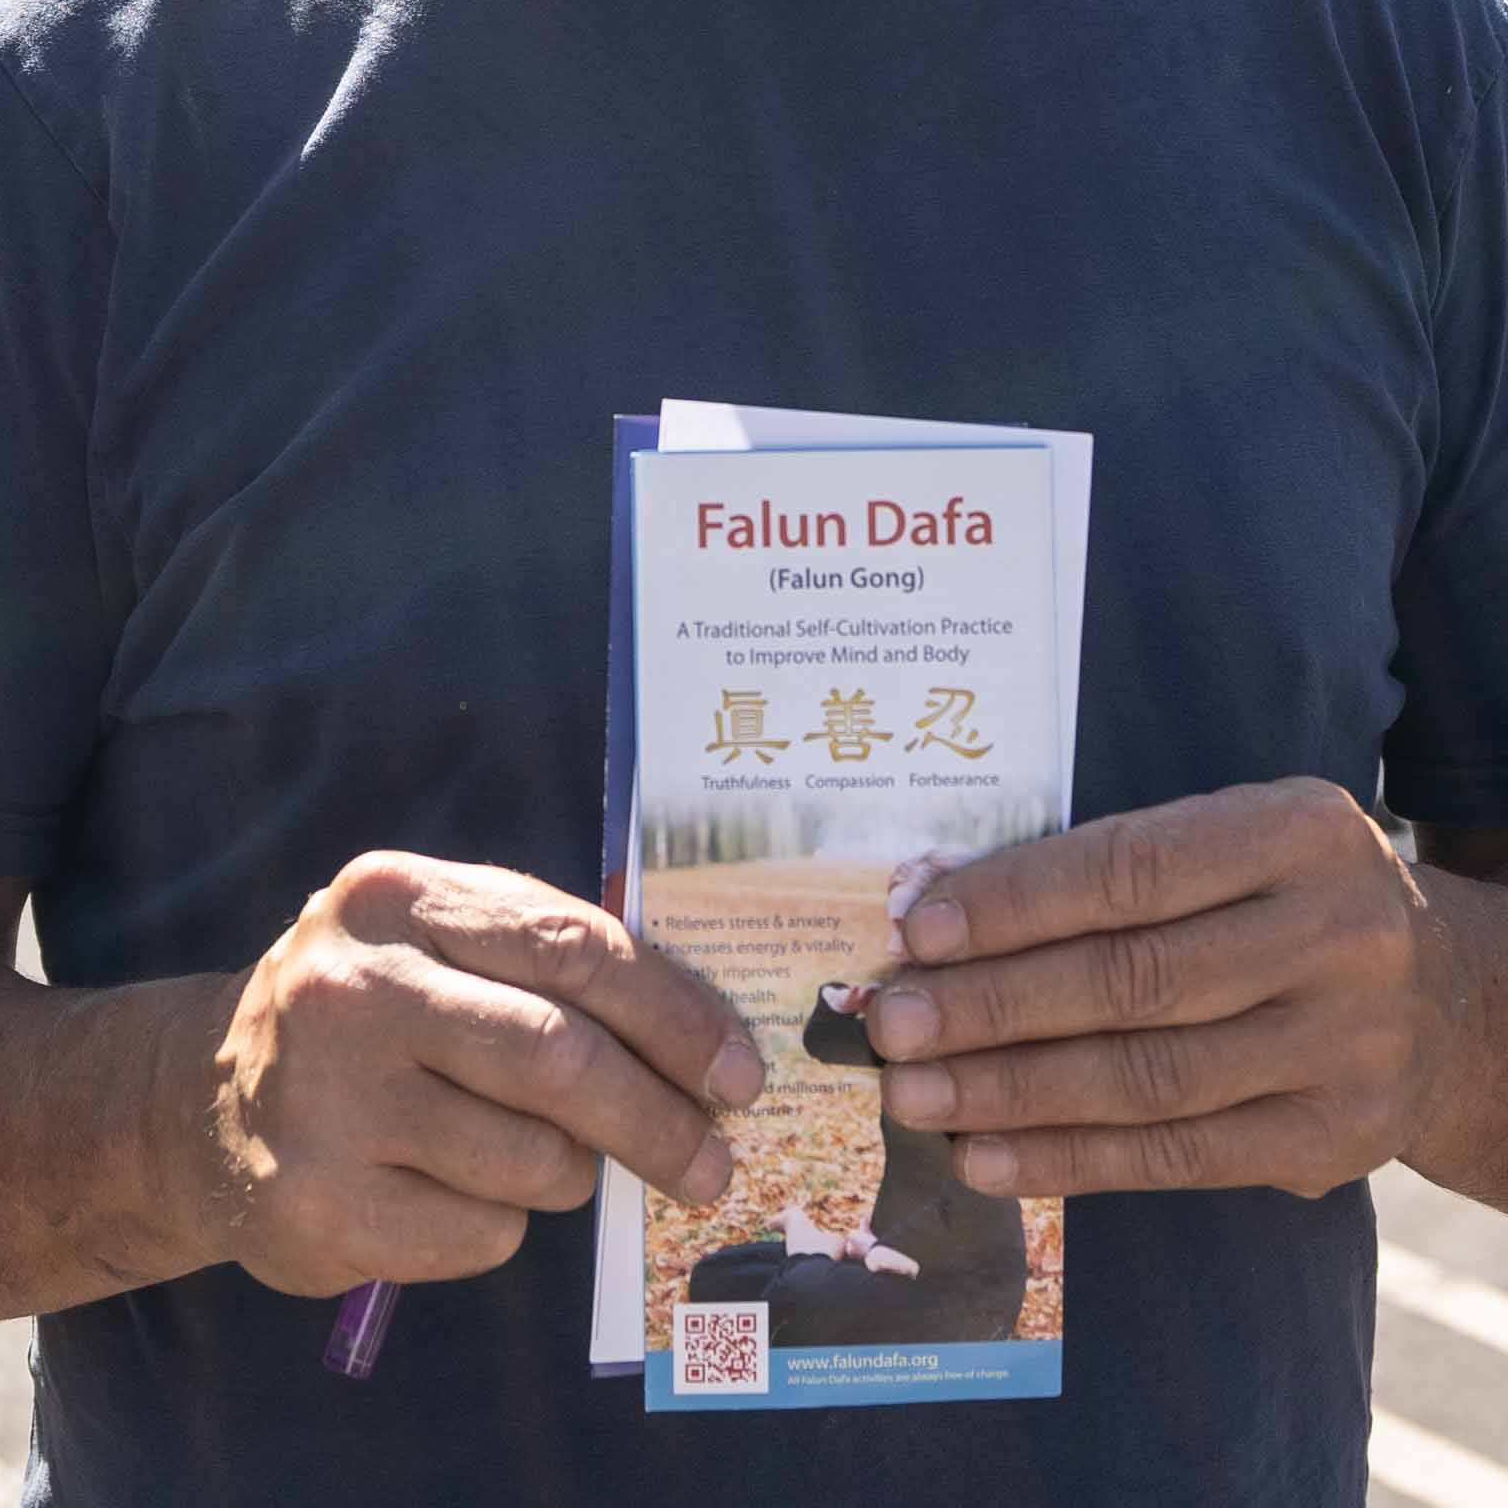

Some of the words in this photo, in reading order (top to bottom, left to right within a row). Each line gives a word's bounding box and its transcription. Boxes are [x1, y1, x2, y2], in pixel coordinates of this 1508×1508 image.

[697, 498, 846, 549] Falun
[867, 495, 993, 547] Dafa
[769, 566, 843, 593] (Falun
[850, 565, 924, 593] Gong)
[676, 622, 690, 639] A
[693, 620, 790, 639] Traditional
[795, 618, 936, 638] Self-Cultivation
[941, 617, 1013, 636] Practice
[726, 650, 745, 665] to
[749, 648, 826, 668] Improve
[830, 645, 878, 664] Mind
[883, 645, 918, 663] and
[923, 645, 970, 666] Body
[701, 774, 792, 790] Truthfulness
[804, 773, 895, 791] Compassion
[909, 771, 1000, 788] Forbearance
[666, 916, 725, 930] Relieves
[729, 917, 769, 930] stress
[772, 915, 783, 929] &
[787, 915, 842, 932] anxiety
[666, 941, 733, 955] Increases
[736, 943, 787, 958] energy
[791, 941, 802, 953] &
[806, 939, 854, 955] vitality
[722, 964, 790, 983] improves
[787, 1352, 939, 1371] www.falundafa.org
